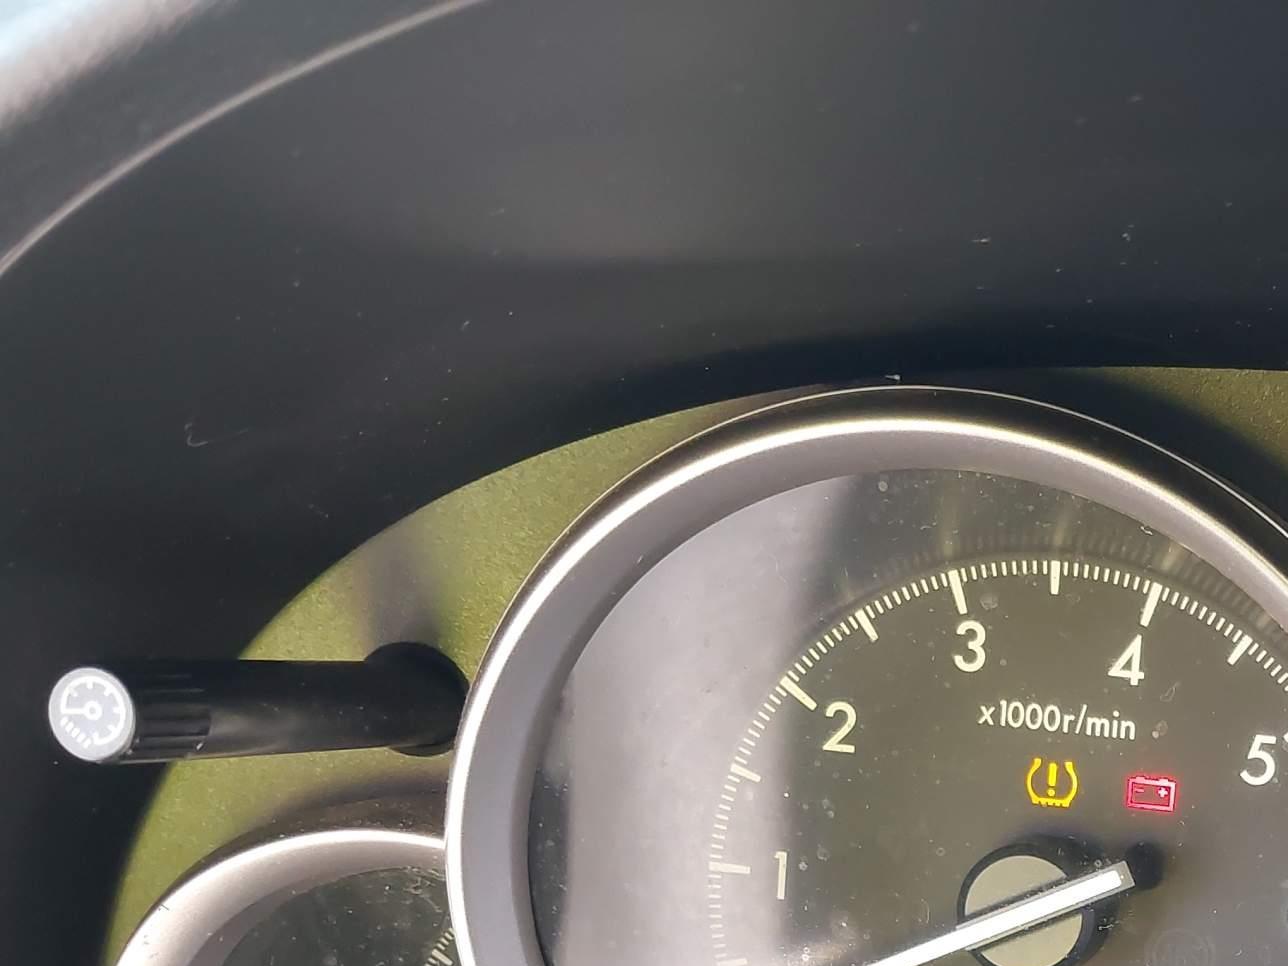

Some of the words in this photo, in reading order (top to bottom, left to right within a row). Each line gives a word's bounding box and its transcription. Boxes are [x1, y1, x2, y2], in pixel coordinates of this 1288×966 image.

[954, 620, 986, 673] 3
[1108, 634, 1145, 686] 4
[823, 701, 857, 754] 2
[978, 699, 1136, 741] x1000r/min
[1239, 734, 1277, 786] 5
[774, 851, 788, 900] 1
